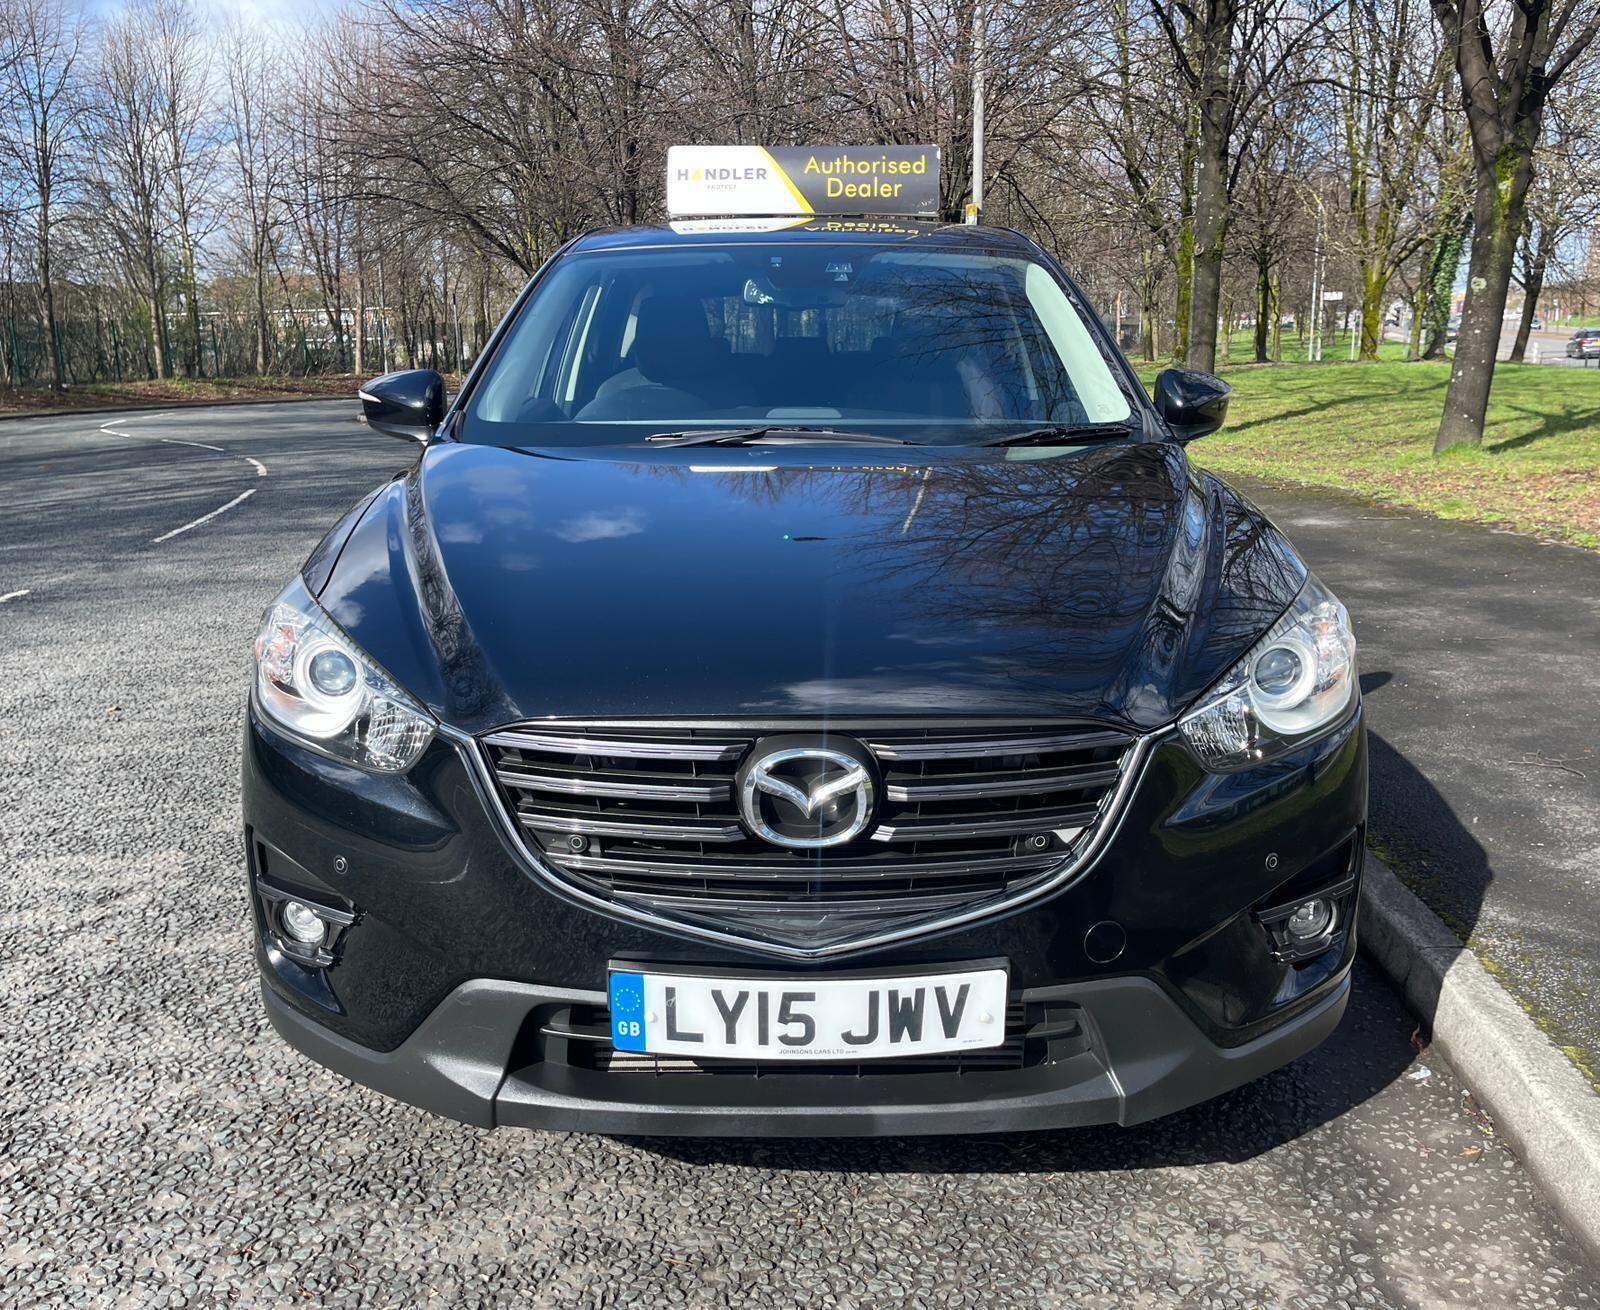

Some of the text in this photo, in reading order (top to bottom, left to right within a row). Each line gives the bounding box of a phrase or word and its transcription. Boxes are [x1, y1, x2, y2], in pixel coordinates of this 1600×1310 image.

[804, 155, 926, 175] Authorised
[827, 178, 903, 197] Dealer
[665, 983, 971, 1046] LY15 JWV
[617, 1020, 641, 1037] GB
